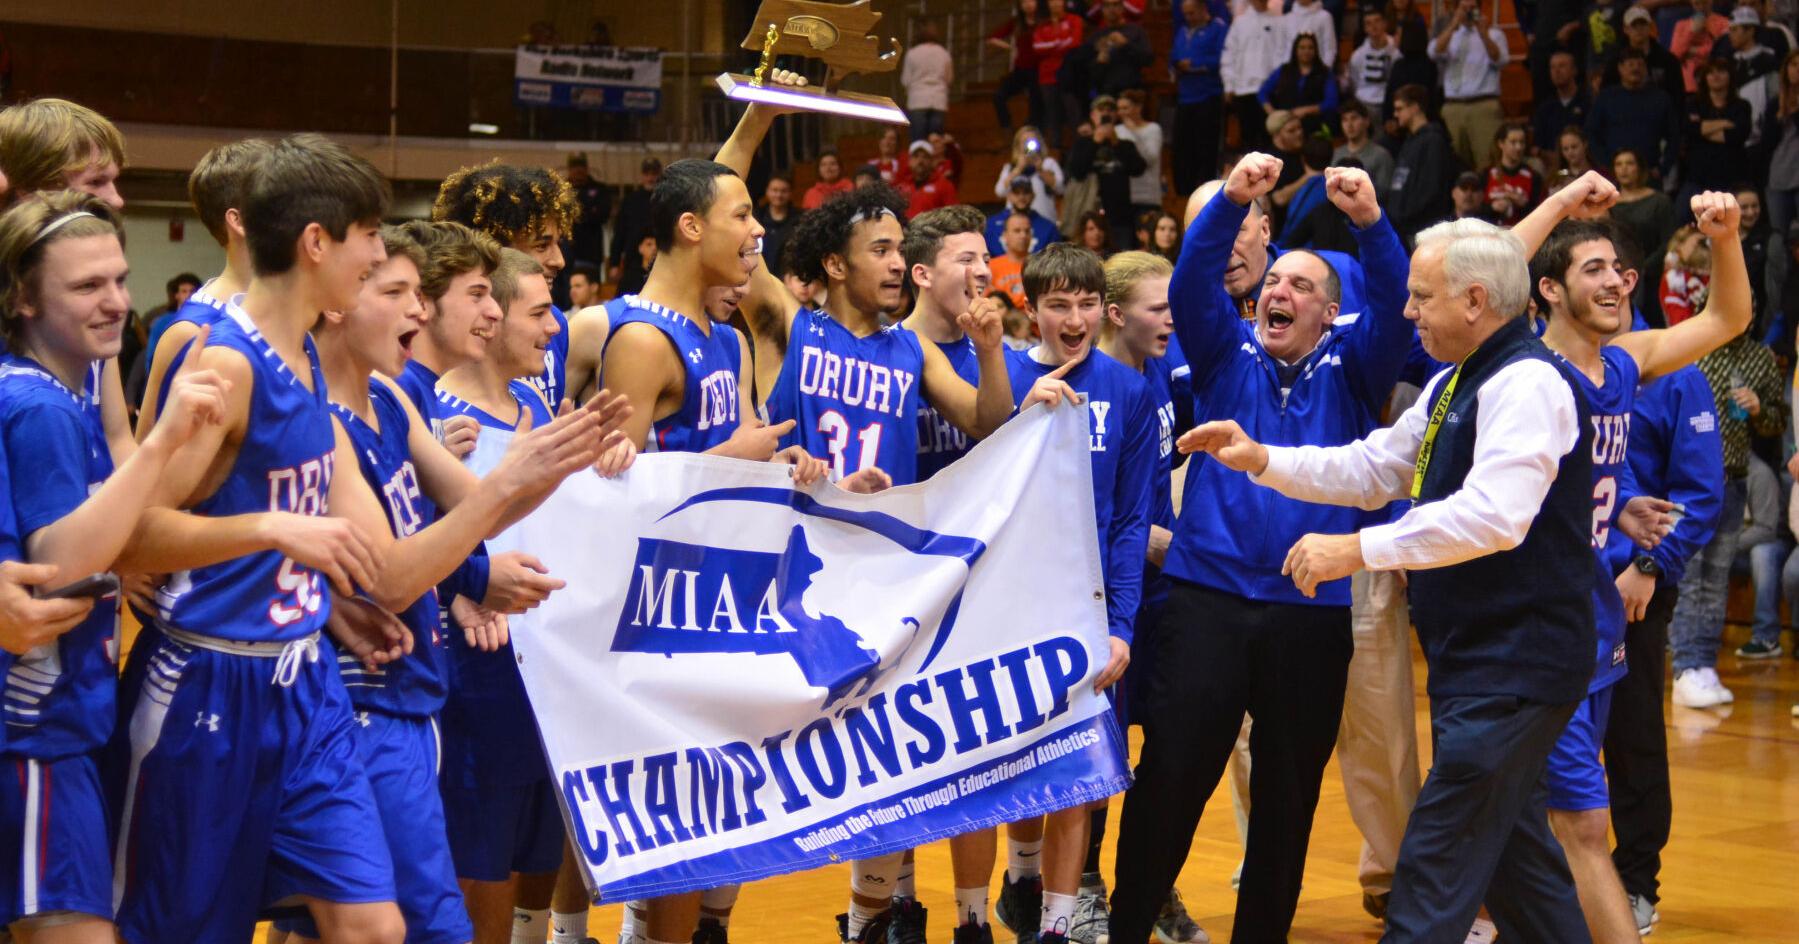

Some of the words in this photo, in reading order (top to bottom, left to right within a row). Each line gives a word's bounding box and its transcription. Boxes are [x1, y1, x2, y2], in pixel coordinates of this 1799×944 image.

[579, 63, 635, 81] Network
[800, 345, 914, 418] DRURY
[1431, 390, 1452, 425] MIAA
[817, 410, 881, 483] 31
[631, 565, 798, 634] MIAA
[562, 637, 1089, 867] CHAMPIONSHIP
[794, 823, 850, 853] Building
[850, 814, 871, 834] the
[870, 805, 905, 825] Future
[902, 783, 959, 816] Through
[958, 754, 1035, 796] Educational
[1036, 728, 1100, 769] Athletics
